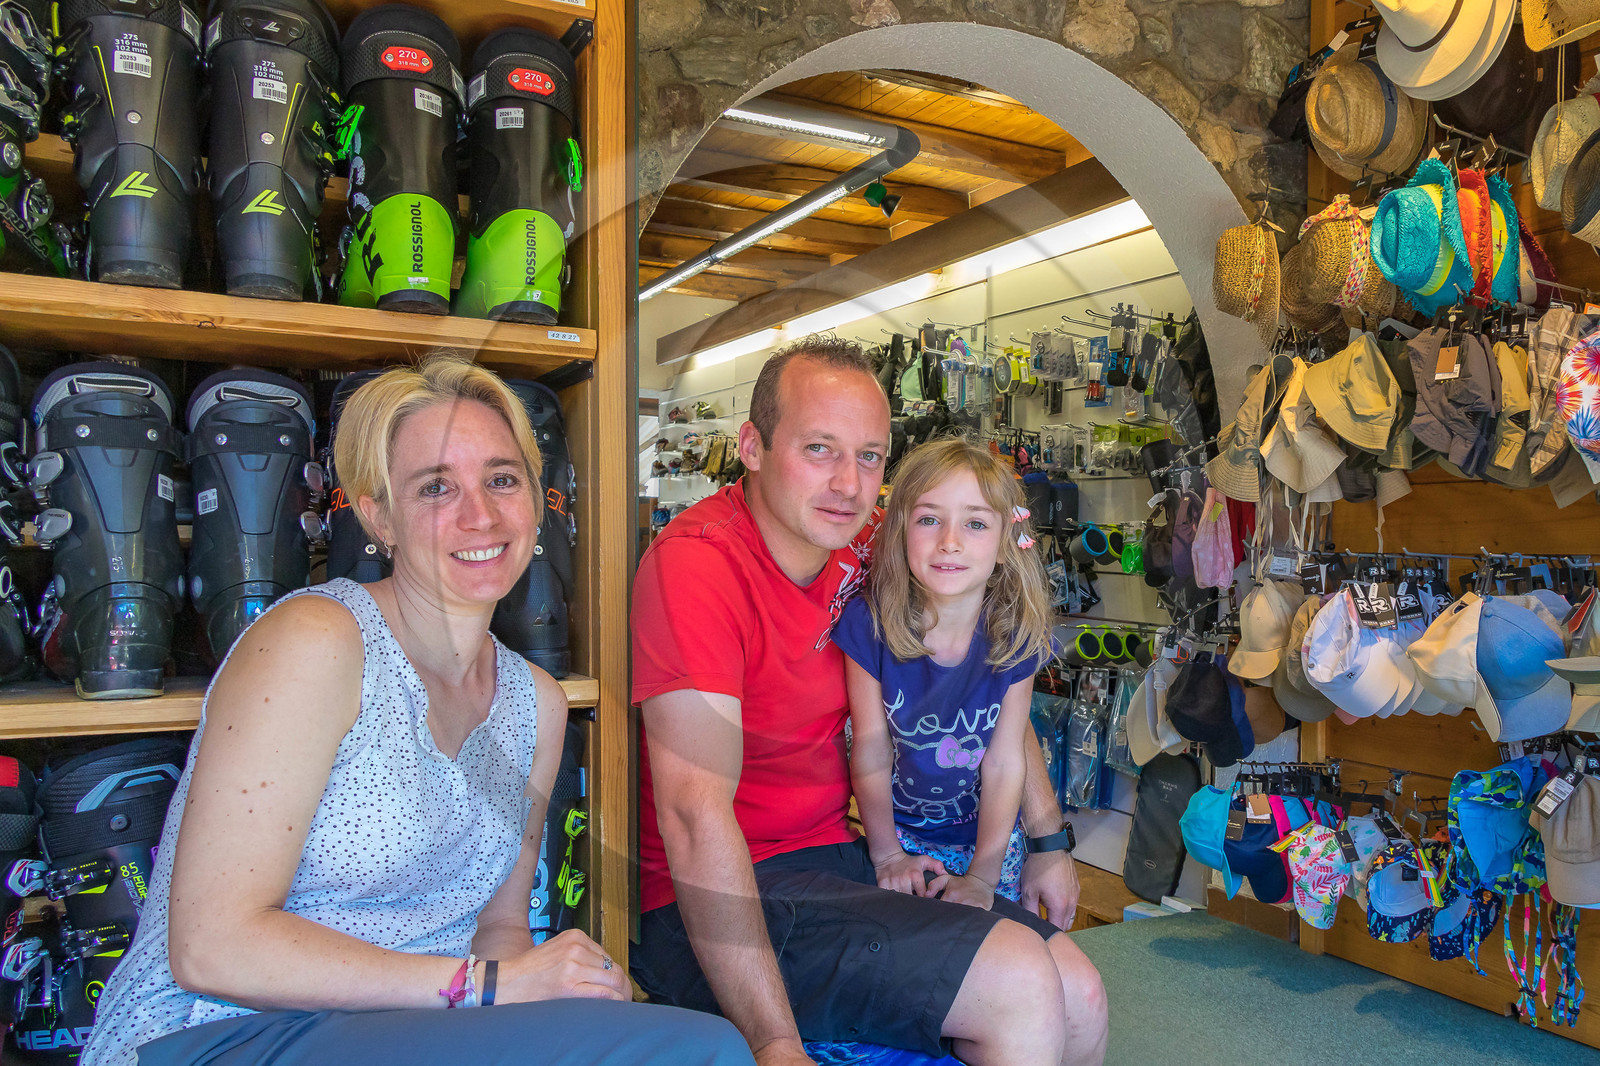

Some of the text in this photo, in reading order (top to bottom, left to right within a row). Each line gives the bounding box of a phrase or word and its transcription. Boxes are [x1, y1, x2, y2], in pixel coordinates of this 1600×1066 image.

[122, 33, 139, 41] 275
[131, 41, 148, 49] mm
[131, 46, 149, 55] mm
[398, 49, 418, 60] 270
[253, 64, 284, 76] 316 mm
[261, 60, 276, 68] 275
[268, 73, 284, 82] mm
[524, 71, 542, 83] 270
[410, 201, 424, 273] ROSSIGNOL
[525, 216, 537, 286] ROSSIGNOL
[882, 688, 1001, 737] Love
[120, 861, 139, 877] 85
[15, 1026, 94, 1050] HEAD
